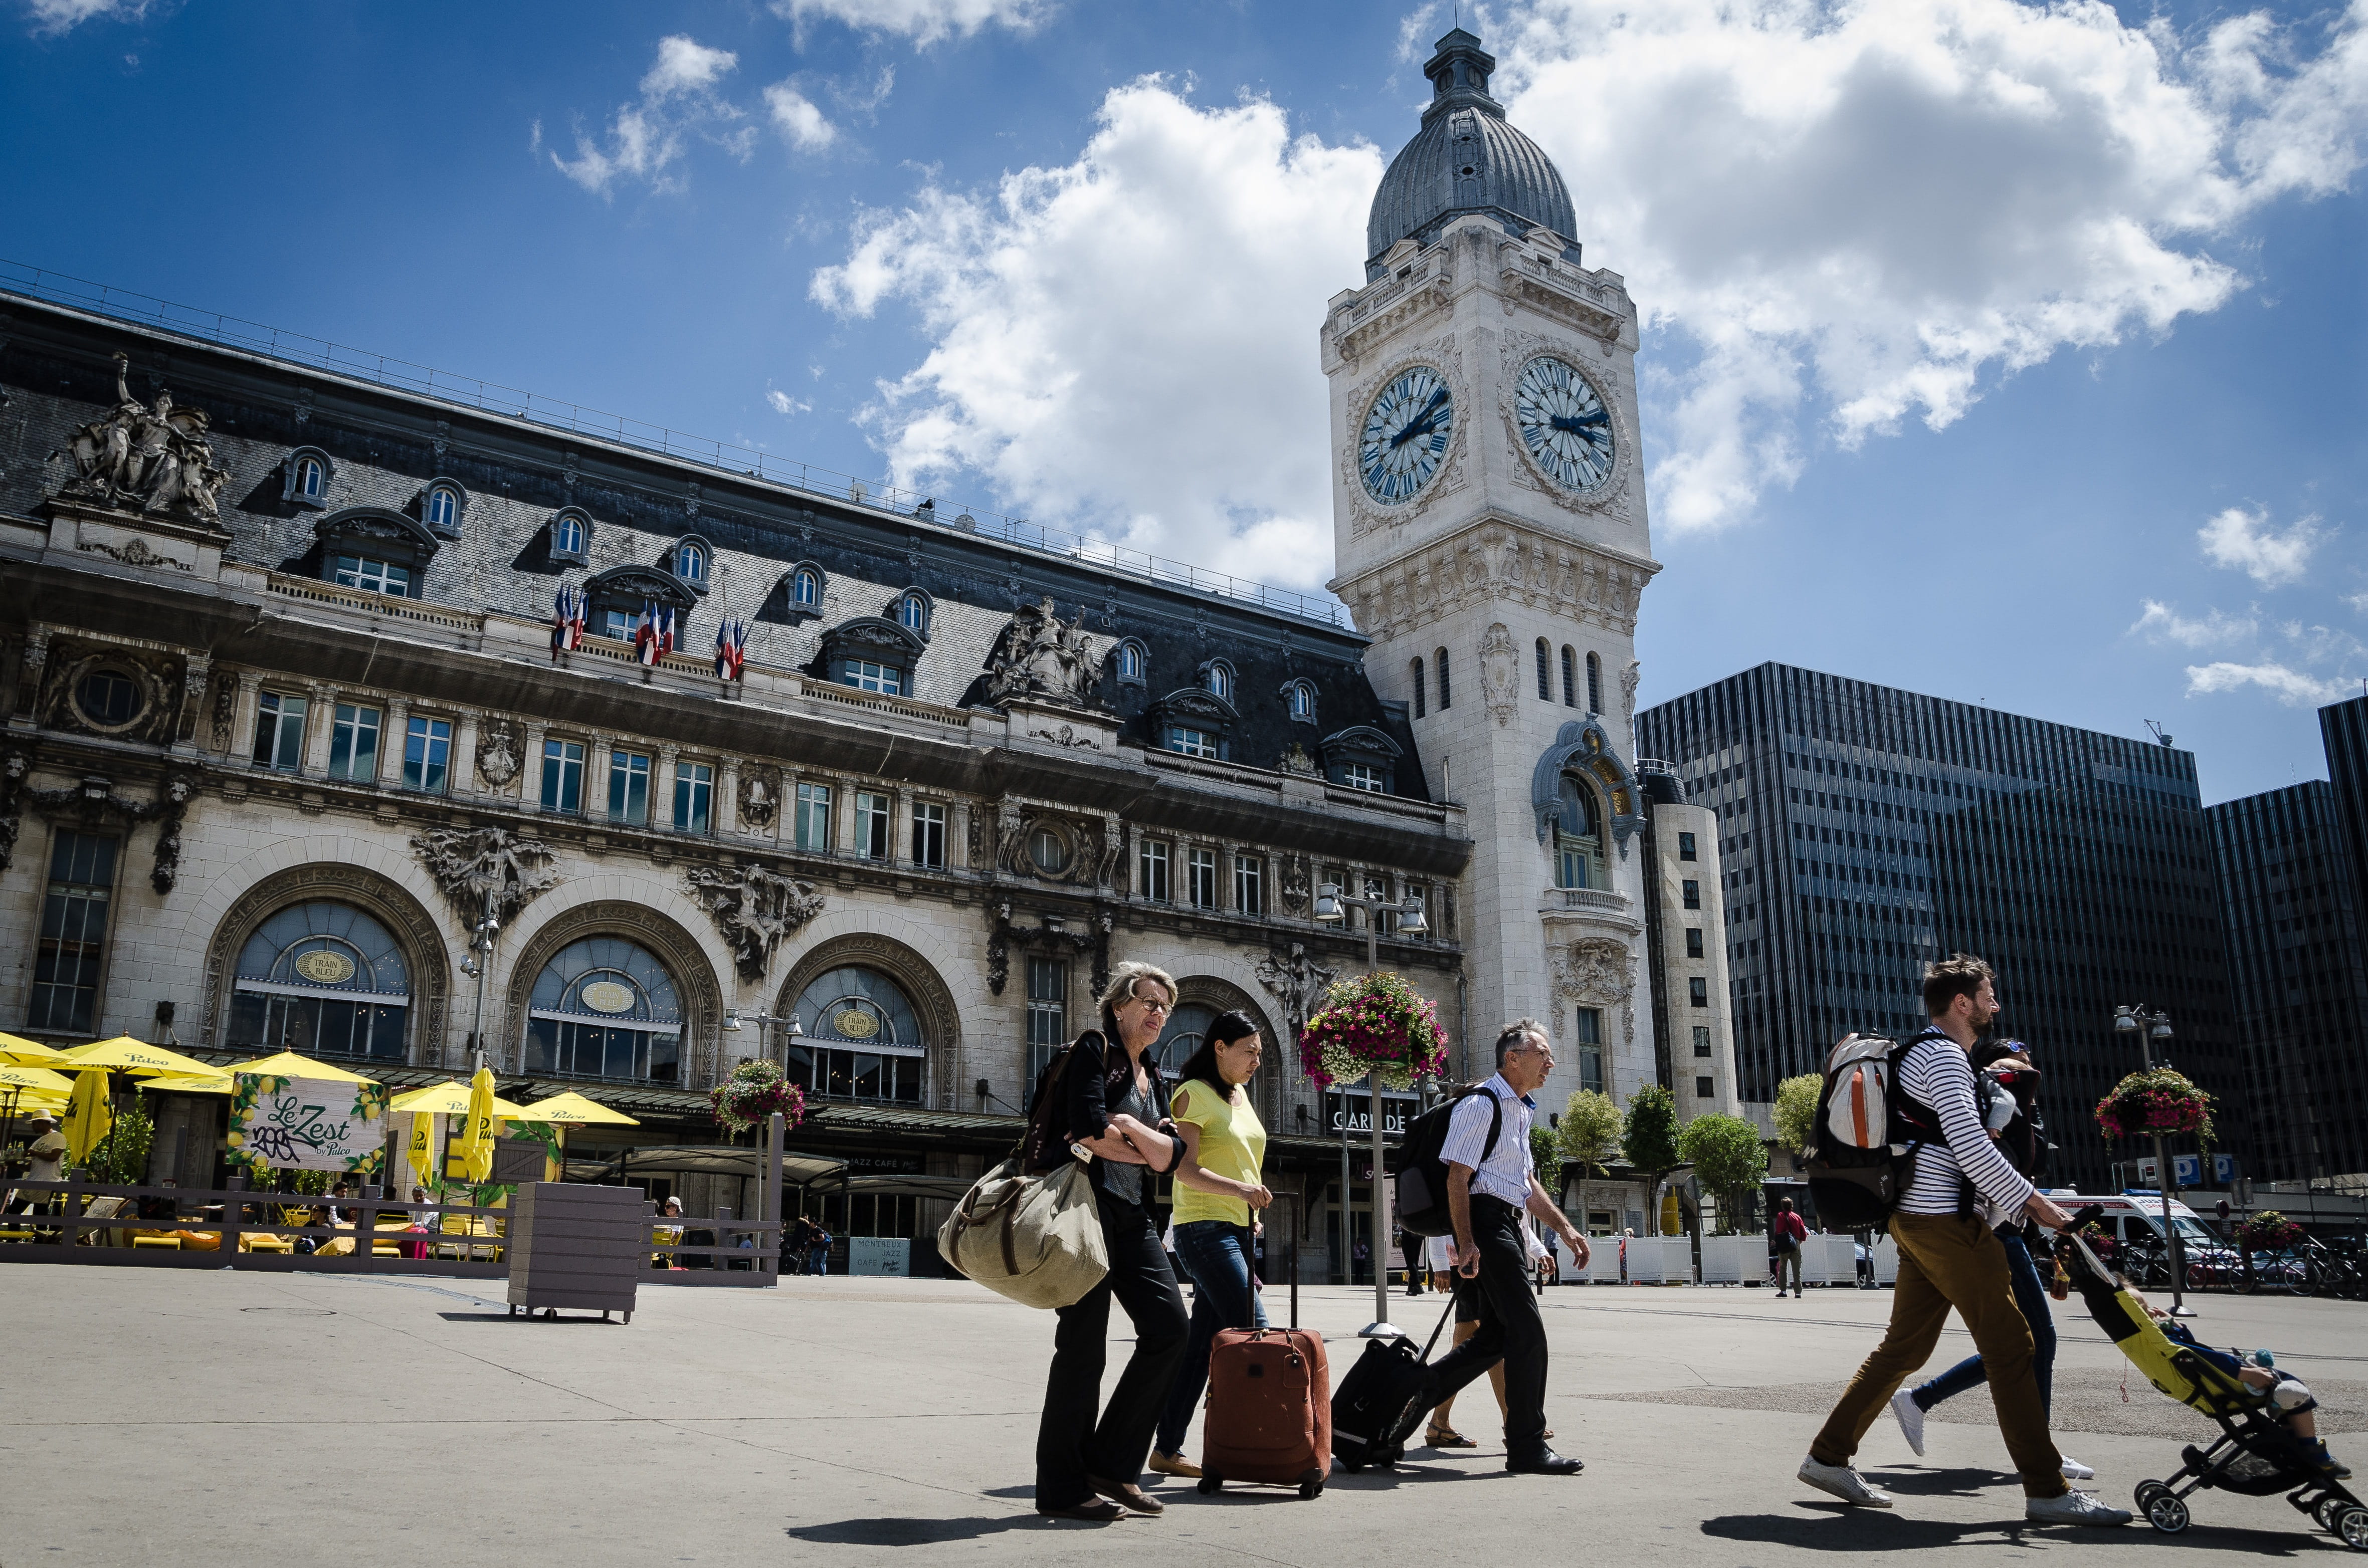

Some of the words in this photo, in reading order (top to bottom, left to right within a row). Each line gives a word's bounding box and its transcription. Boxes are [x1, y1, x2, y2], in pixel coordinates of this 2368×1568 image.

[1554, 366, 1567, 389] XII
[1398, 377, 1409, 400] XII
[1417, 376, 1426, 396] I
[1575, 384, 1584, 398] I
[314, 959, 338, 968] TRAIN
[316, 968, 336, 976] BLEU
[848, 1017, 866, 1025] TRAIN
[124, 1053, 169, 1065] Pulco
[1, 1073, 39, 1084] Pulco
[268, 1096, 299, 1129] Le
[292, 1104, 351, 1146] Zest
[551, 1110, 585, 1118] Pulco
[1333, 1111, 1373, 1129] GAR
[1387, 1115, 1406, 1131] DE
[315, 1148, 326, 1156] by
[327, 1142, 351, 1156] Pulco
[875, 1159, 897, 1167] CAFÉ
[2214, 1158, 2229, 1181] P
[2174, 1160, 2193, 1184] P
